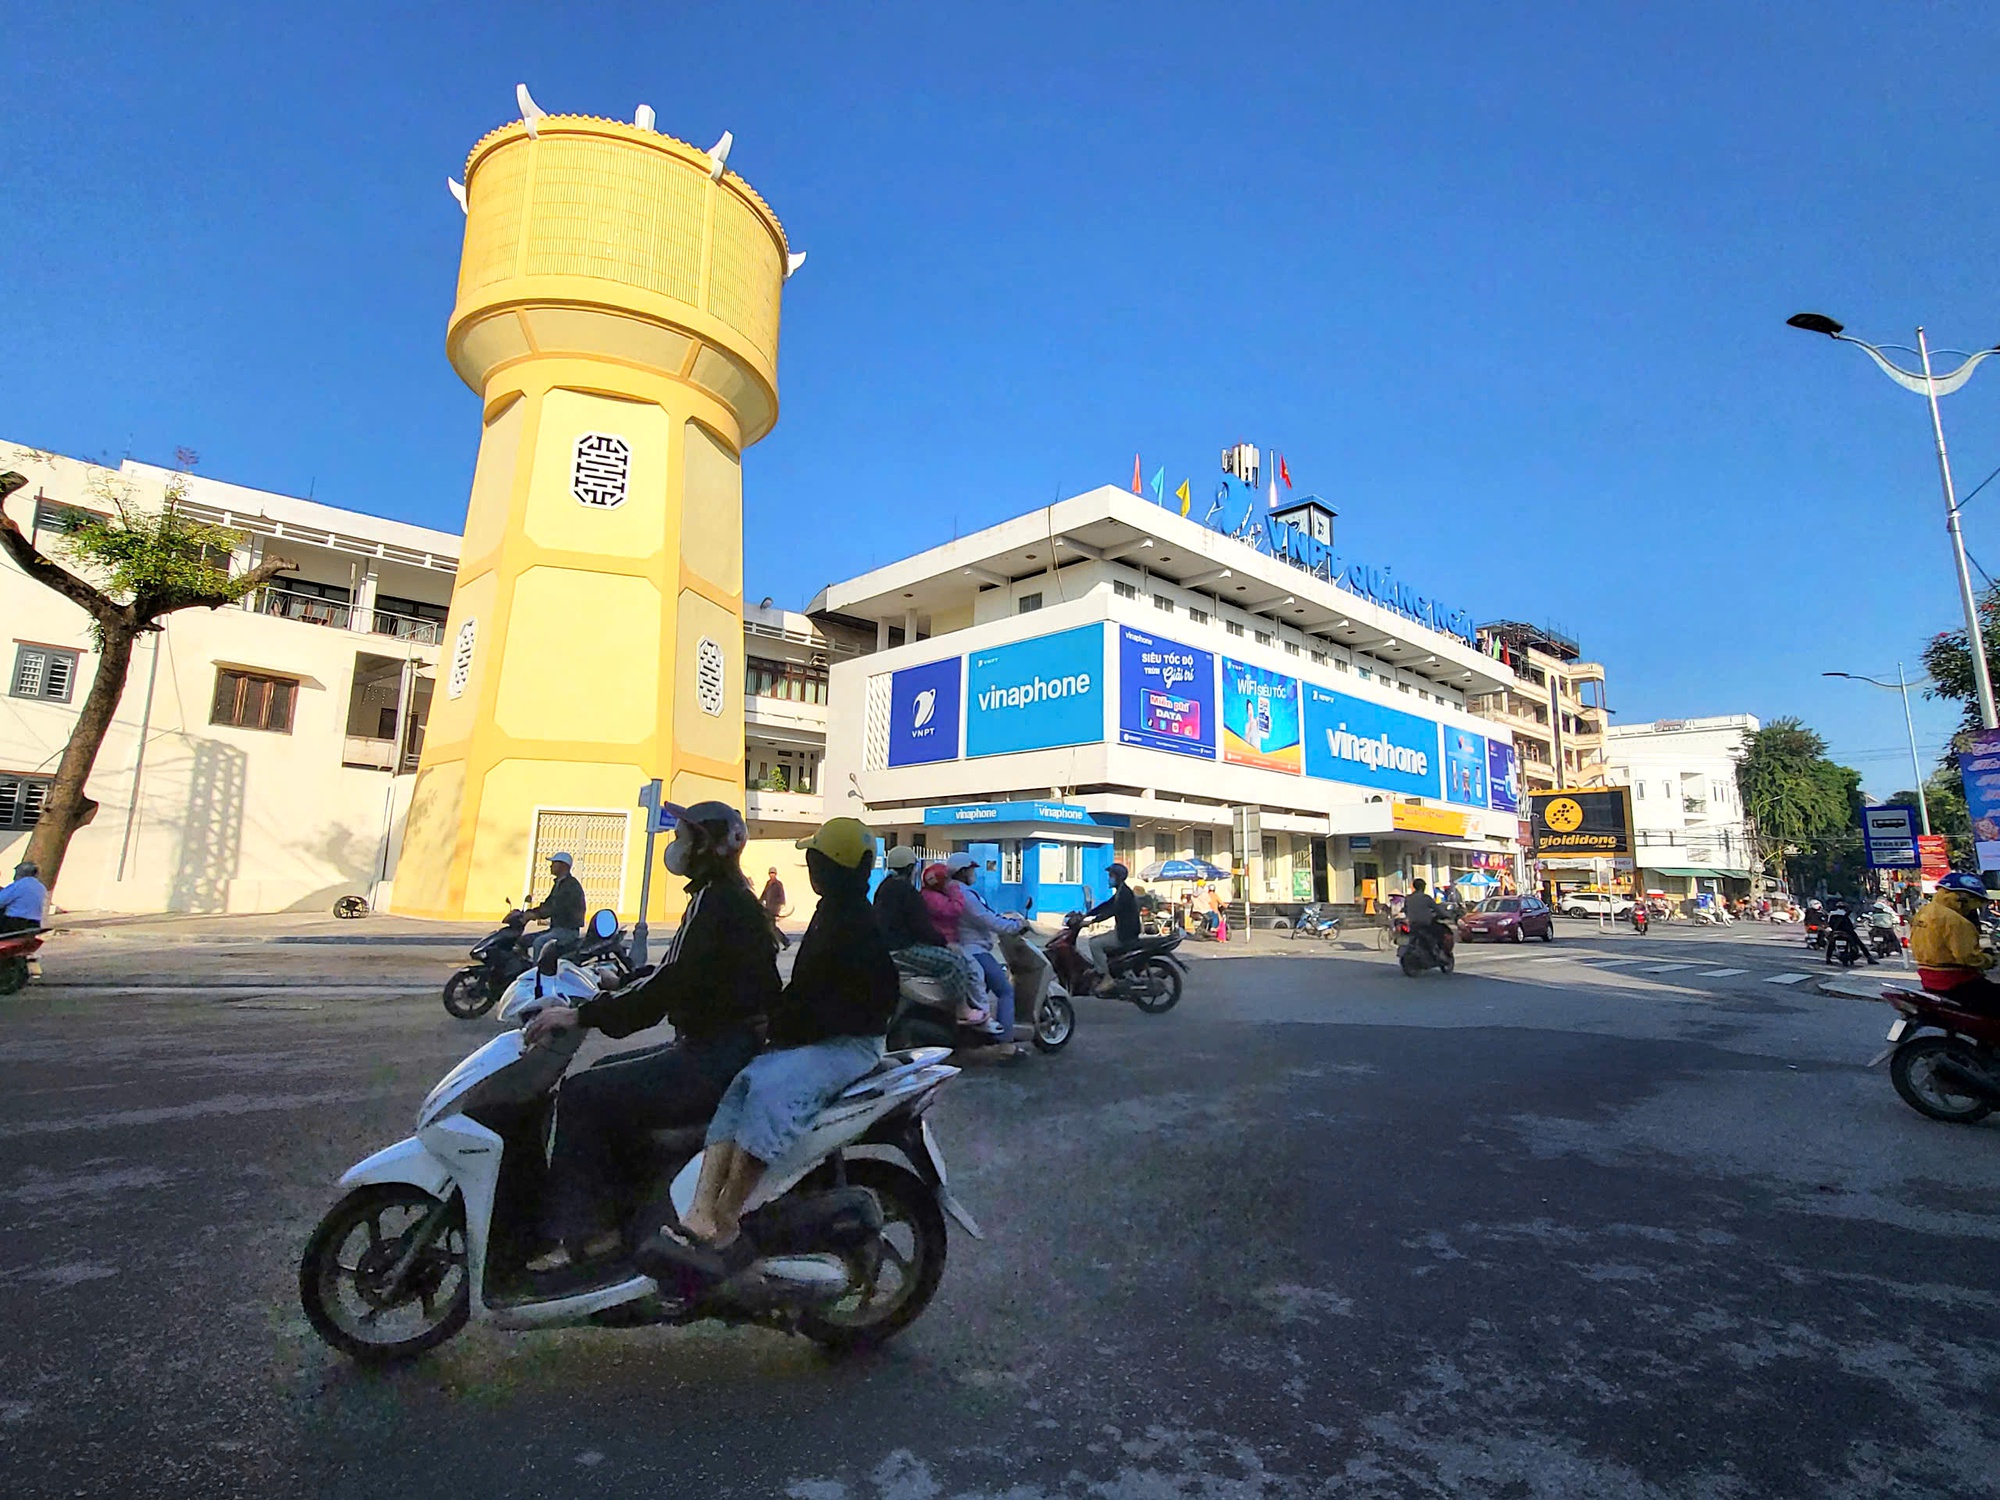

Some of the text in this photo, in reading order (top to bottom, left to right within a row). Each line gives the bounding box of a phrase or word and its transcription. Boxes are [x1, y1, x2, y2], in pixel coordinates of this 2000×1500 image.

[1264, 514, 1342, 579] VNPT
[1125, 631, 1153, 646] vinaphone
[1141, 652, 1162, 664] SIÊU
[1163, 651, 1181, 666] TỐC
[1181, 655, 1194, 669] ĐỘ
[978, 673, 1091, 712] vinaphone
[1237, 678, 1288, 699] WIFI SIÊU TỐC
[1150, 694, 1191, 713] Miễn phí
[1155, 709, 1183, 722] DATA
[911, 727, 935, 738] VNPT
[1325, 722, 1428, 776] vinaphone
[955, 807, 997, 820] vinaphone
[1038, 806, 1083, 820] vinaphone
